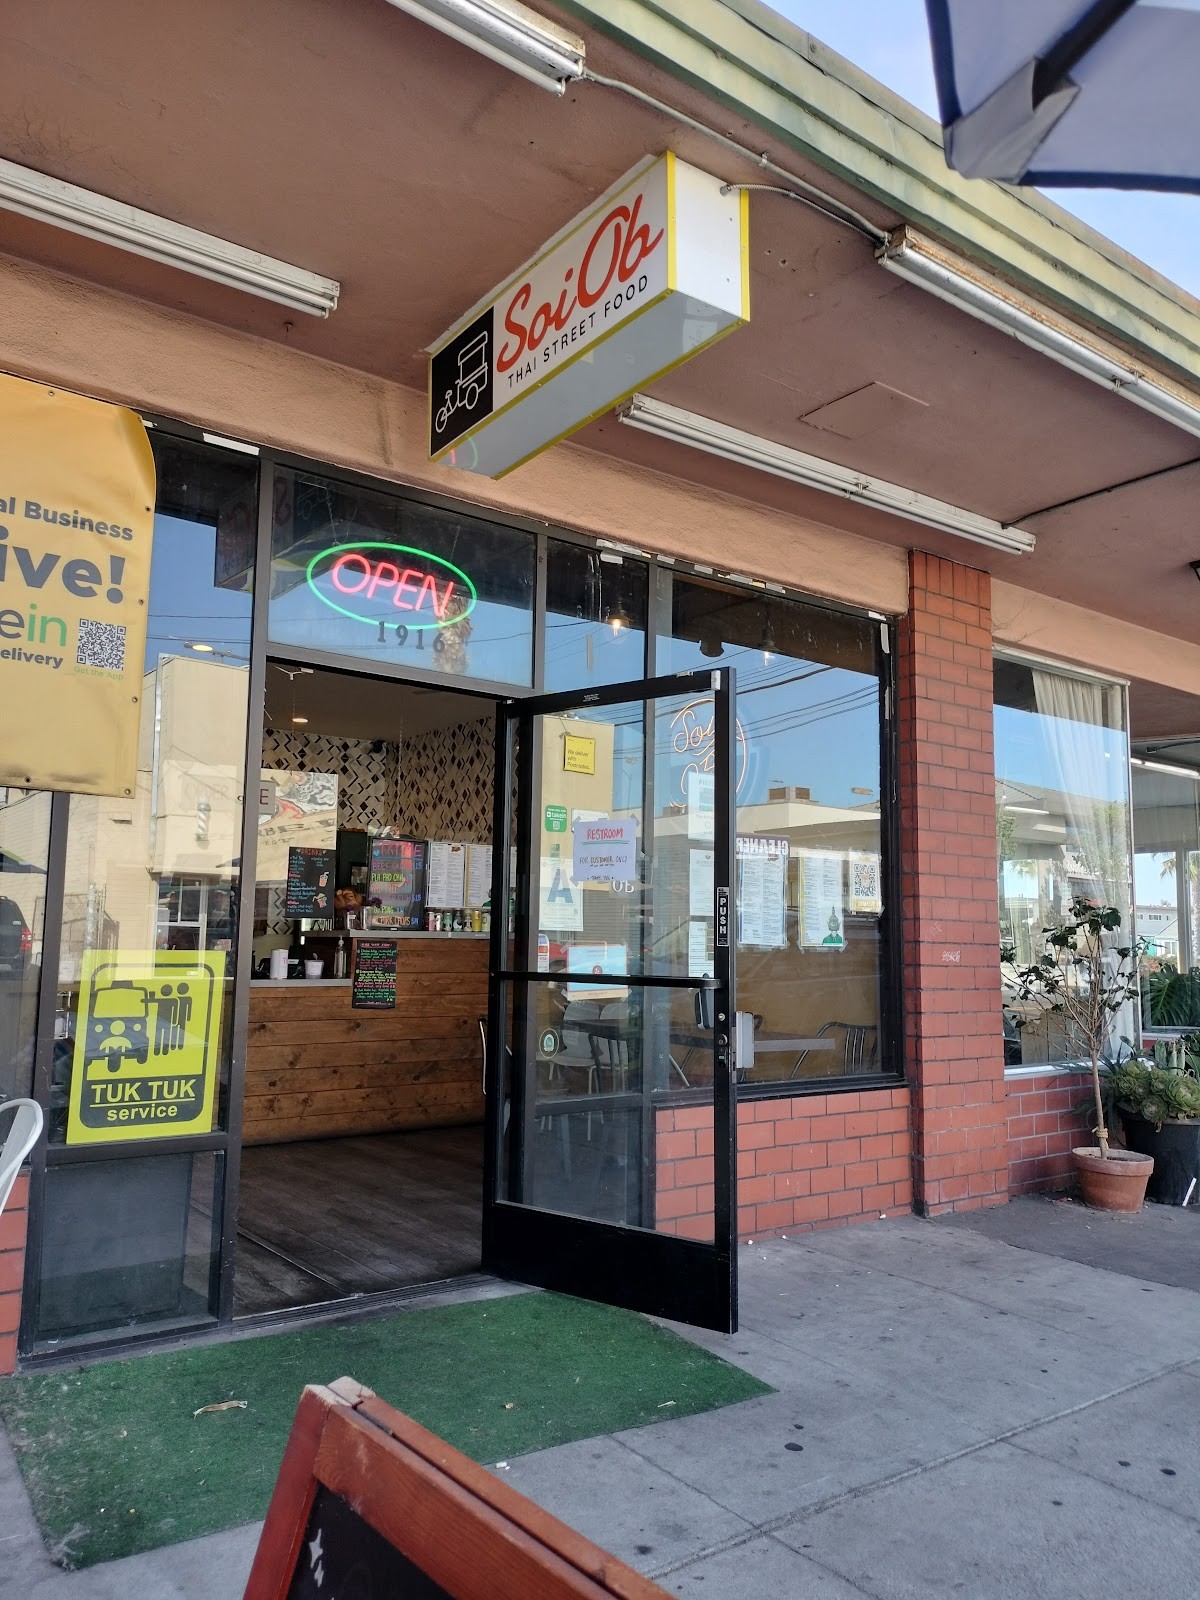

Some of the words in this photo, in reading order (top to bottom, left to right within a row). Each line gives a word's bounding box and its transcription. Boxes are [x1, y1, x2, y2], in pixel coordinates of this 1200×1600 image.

[508, 357, 536, 388] THAI
[543, 312, 596, 362] STREET
[604, 275, 648, 318] FOOD
[24, 500, 133, 541] Business
[332, 554, 455, 617] OPEN
[377, 621, 446, 653] 1916
[74, 666, 90, 675] Get
[91, 668, 104, 677] the
[107, 671, 124, 681] App
[587, 828, 624, 840] RESTROOM
[547, 868, 573, 904] A
[719, 898, 727, 934] PUSH
[91, 1082, 141, 1104] TUK
[148, 1079, 197, 1100] TUK
[107, 1103, 178, 1121] service
